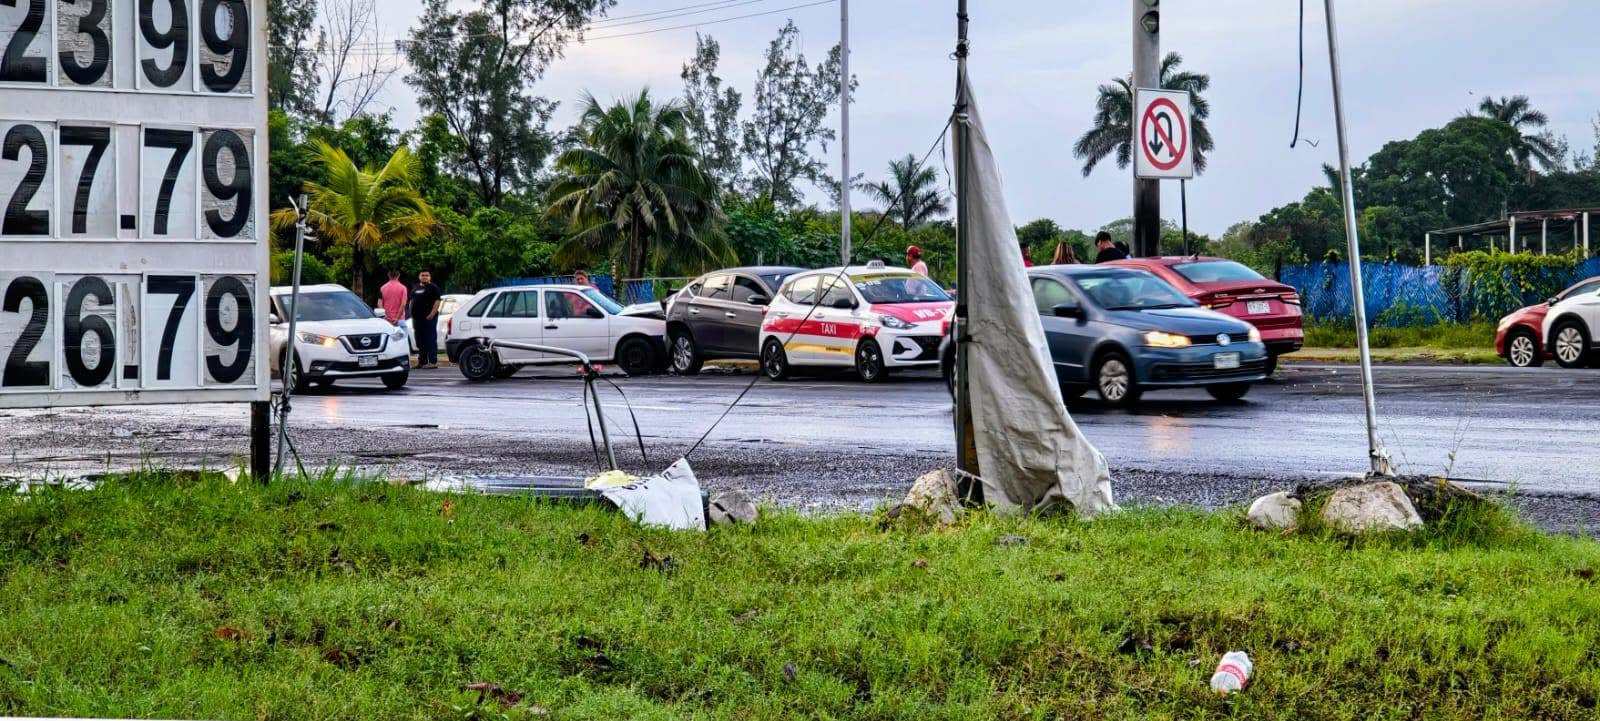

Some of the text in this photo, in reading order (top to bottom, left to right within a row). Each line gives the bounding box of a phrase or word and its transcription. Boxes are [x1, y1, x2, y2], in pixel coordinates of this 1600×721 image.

[1, 125, 252, 237] 27.79
[2, 275, 254, 387] 26.79
[821, 323, 837, 335] TAXI
